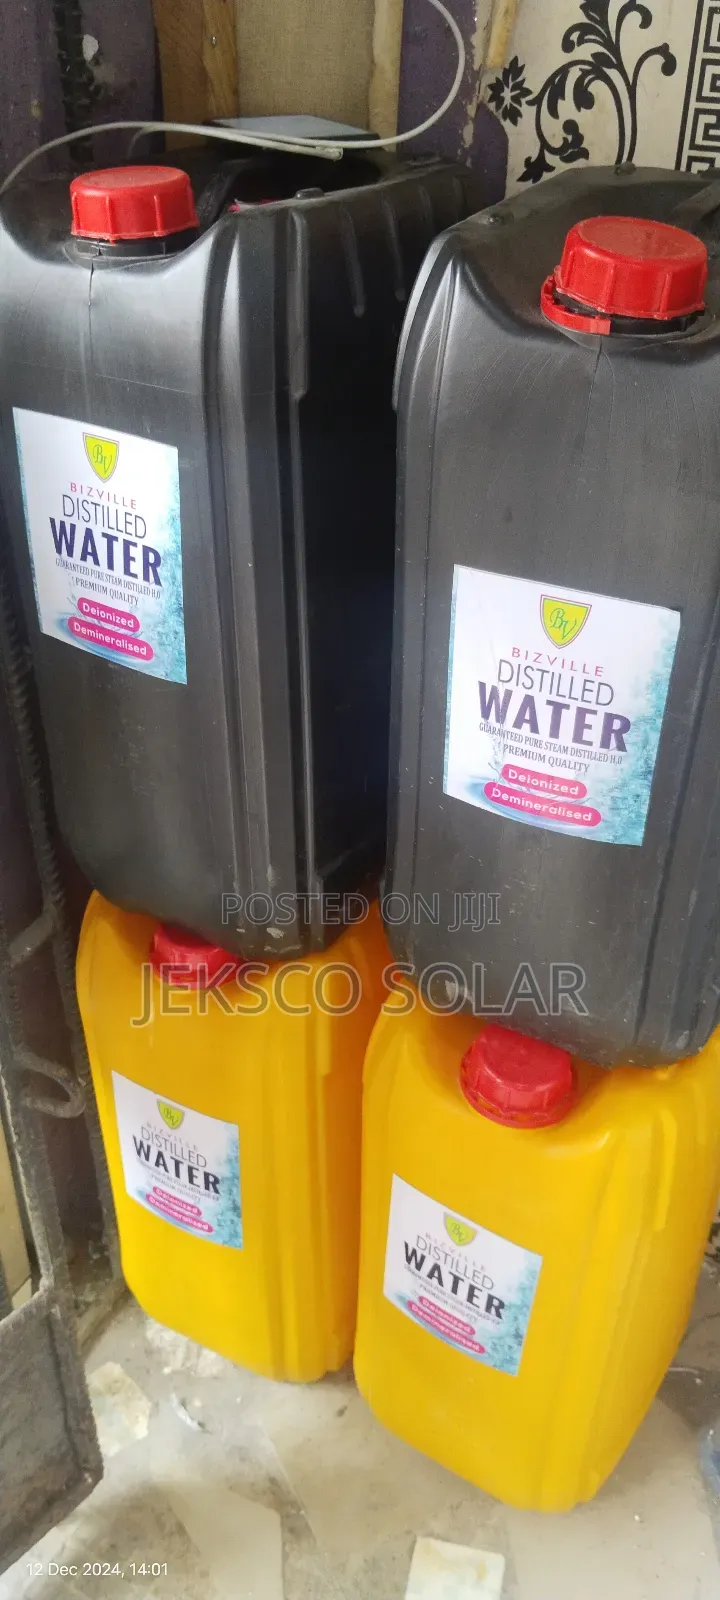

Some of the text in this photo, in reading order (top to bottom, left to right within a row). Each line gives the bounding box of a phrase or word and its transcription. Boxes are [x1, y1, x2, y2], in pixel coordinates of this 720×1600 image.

[69, 482, 137, 510] BIZVILLE
[62, 494, 147, 539] DISTILLED
[49, 516, 163, 587] WATER
[55, 557, 90, 577] GUARANTEED
[90, 568, 104, 582] PURE
[104, 573, 122, 588] STEAM
[123, 579, 151, 596] DISTILLED
[75, 576, 139, 606] PREMIUM QUALITY
[82, 602, 135, 629] Deionized
[73, 621, 147, 656] Demineralised
[511, 646, 604, 677] BIZVILLE
[497, 658, 614, 706] DISTILLED
[477, 680, 631, 752] WATER
[479, 721, 523, 744] GUARANTEED
[524, 735, 544, 750] PURE
[544, 741, 569, 756] STEAM
[570, 746, 609, 763] DISTILLED
[503, 743, 590, 773] PREMIUM QUALITY
[508, 768, 579, 796] Deionized
[491, 787, 593, 822] Demineralised
[132, 1134, 220, 1195] WATER
[141, 1125, 207, 1168] DISTILLED
[404, 1240, 504, 1320] WATER
[416, 1234, 494, 1290] DISTILLED
